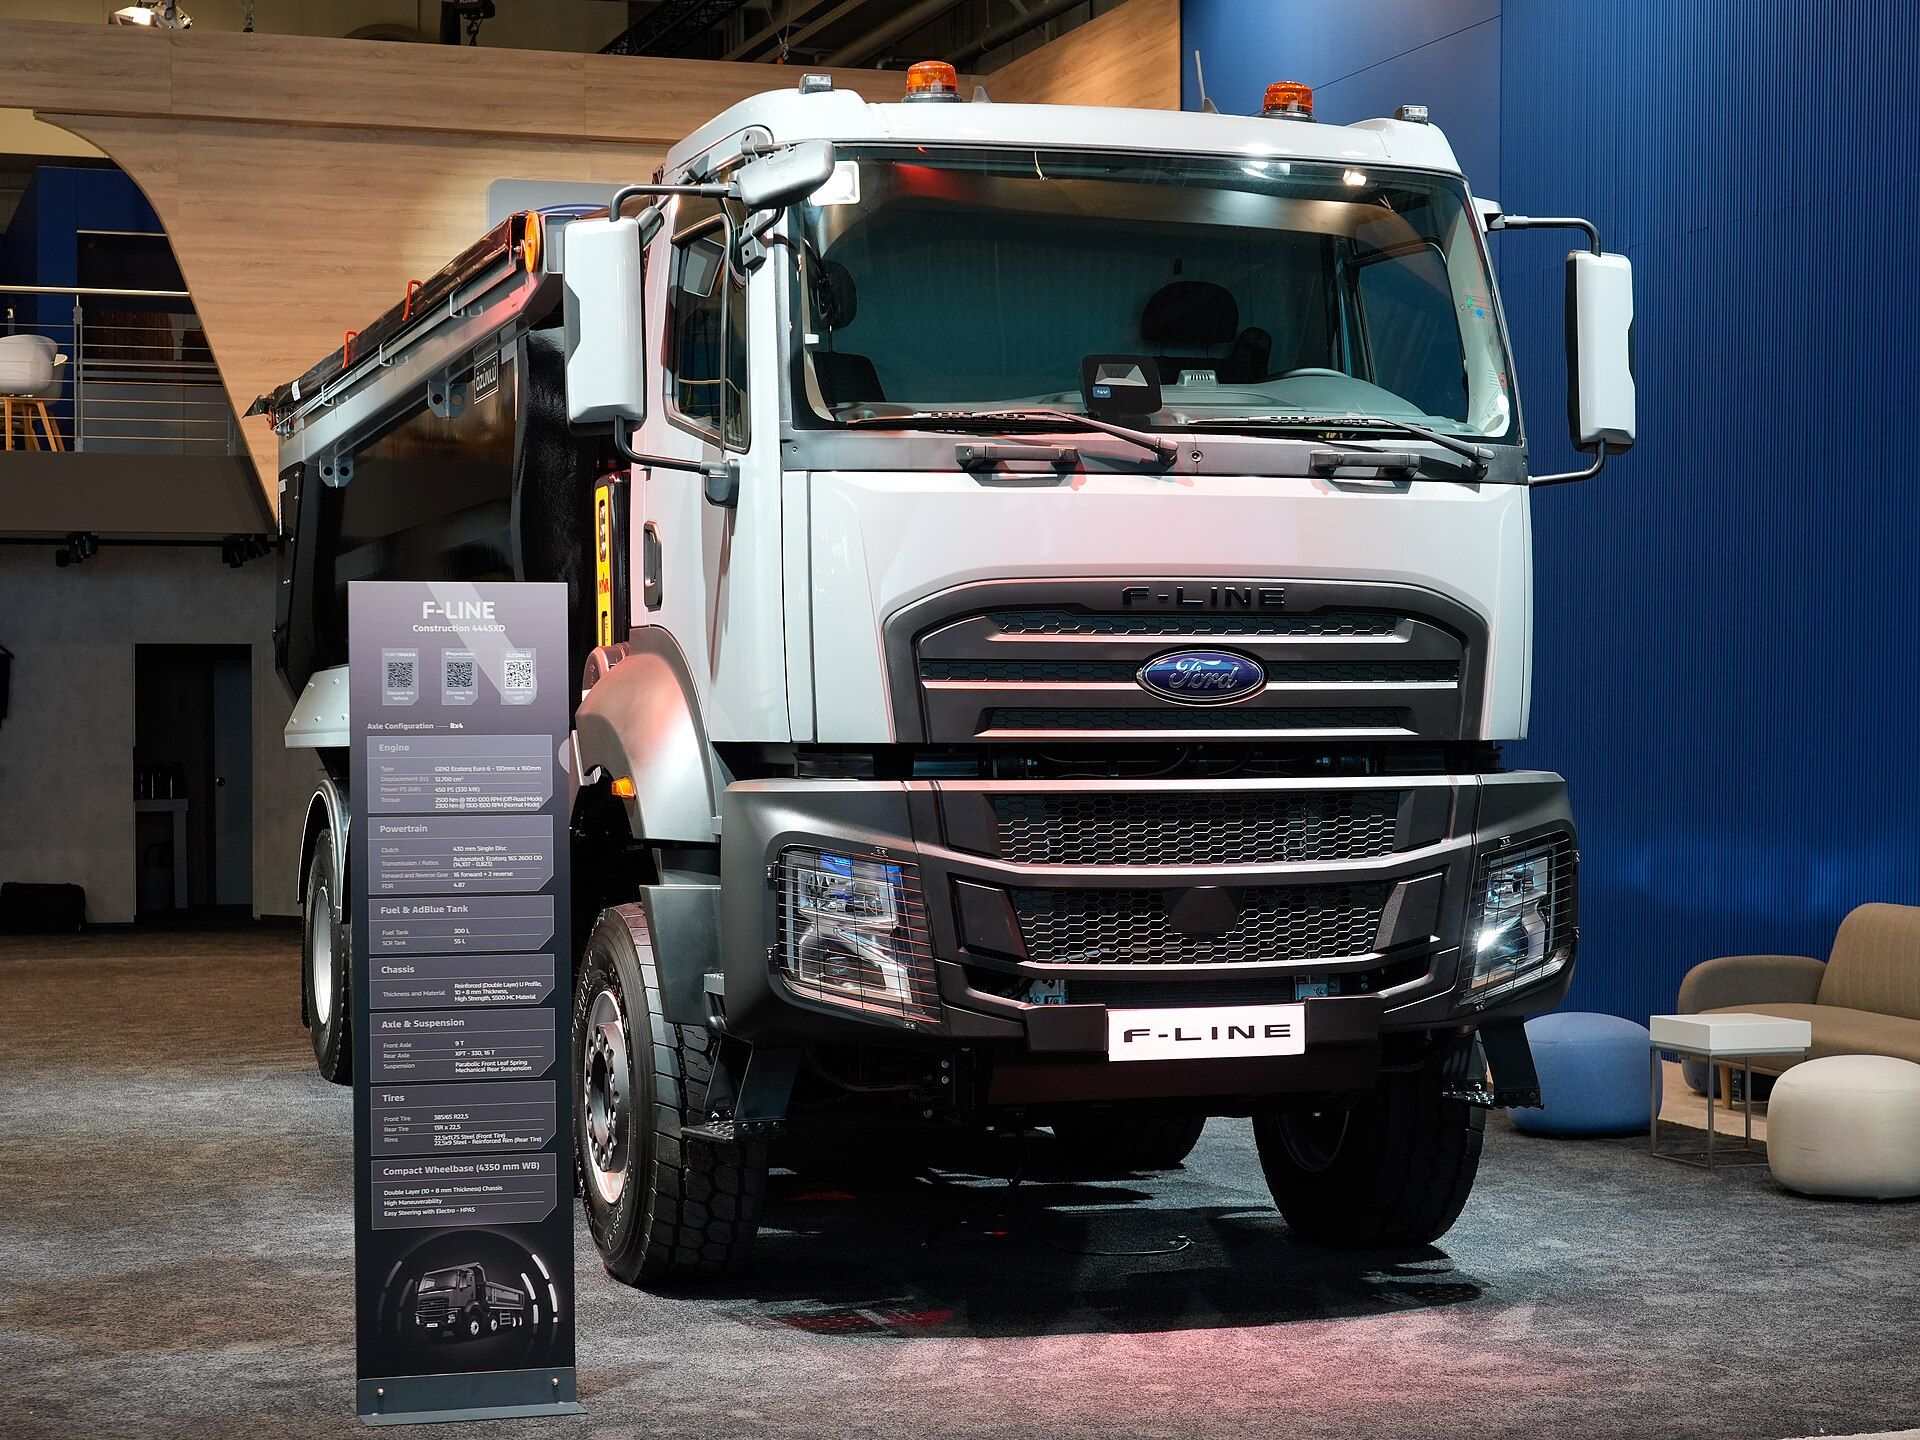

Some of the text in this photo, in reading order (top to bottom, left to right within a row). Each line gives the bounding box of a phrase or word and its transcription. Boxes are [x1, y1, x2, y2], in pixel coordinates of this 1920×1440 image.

[476, 362, 497, 391] ÖZÜNLÜ
[1122, 586, 1286, 606] F-LINE
[422, 601, 496, 619] F-LINE
[1168, 658, 1240, 690] Ford
[379, 744, 410, 752] Engine
[380, 825, 428, 833] Powertrain
[412, 905, 444, 914] AdBlue
[381, 965, 415, 974] Chassis
[382, 1020, 402, 1028] Axle
[414, 1018, 464, 1028] Suspension
[1123, 1024, 1290, 1043] F-LINE
[383, 1166, 423, 1176] Compact
[425, 1165, 474, 1174] Wheelbase
[476, 1163, 501, 1173] (4350
[522, 1162, 540, 1170] WB)
